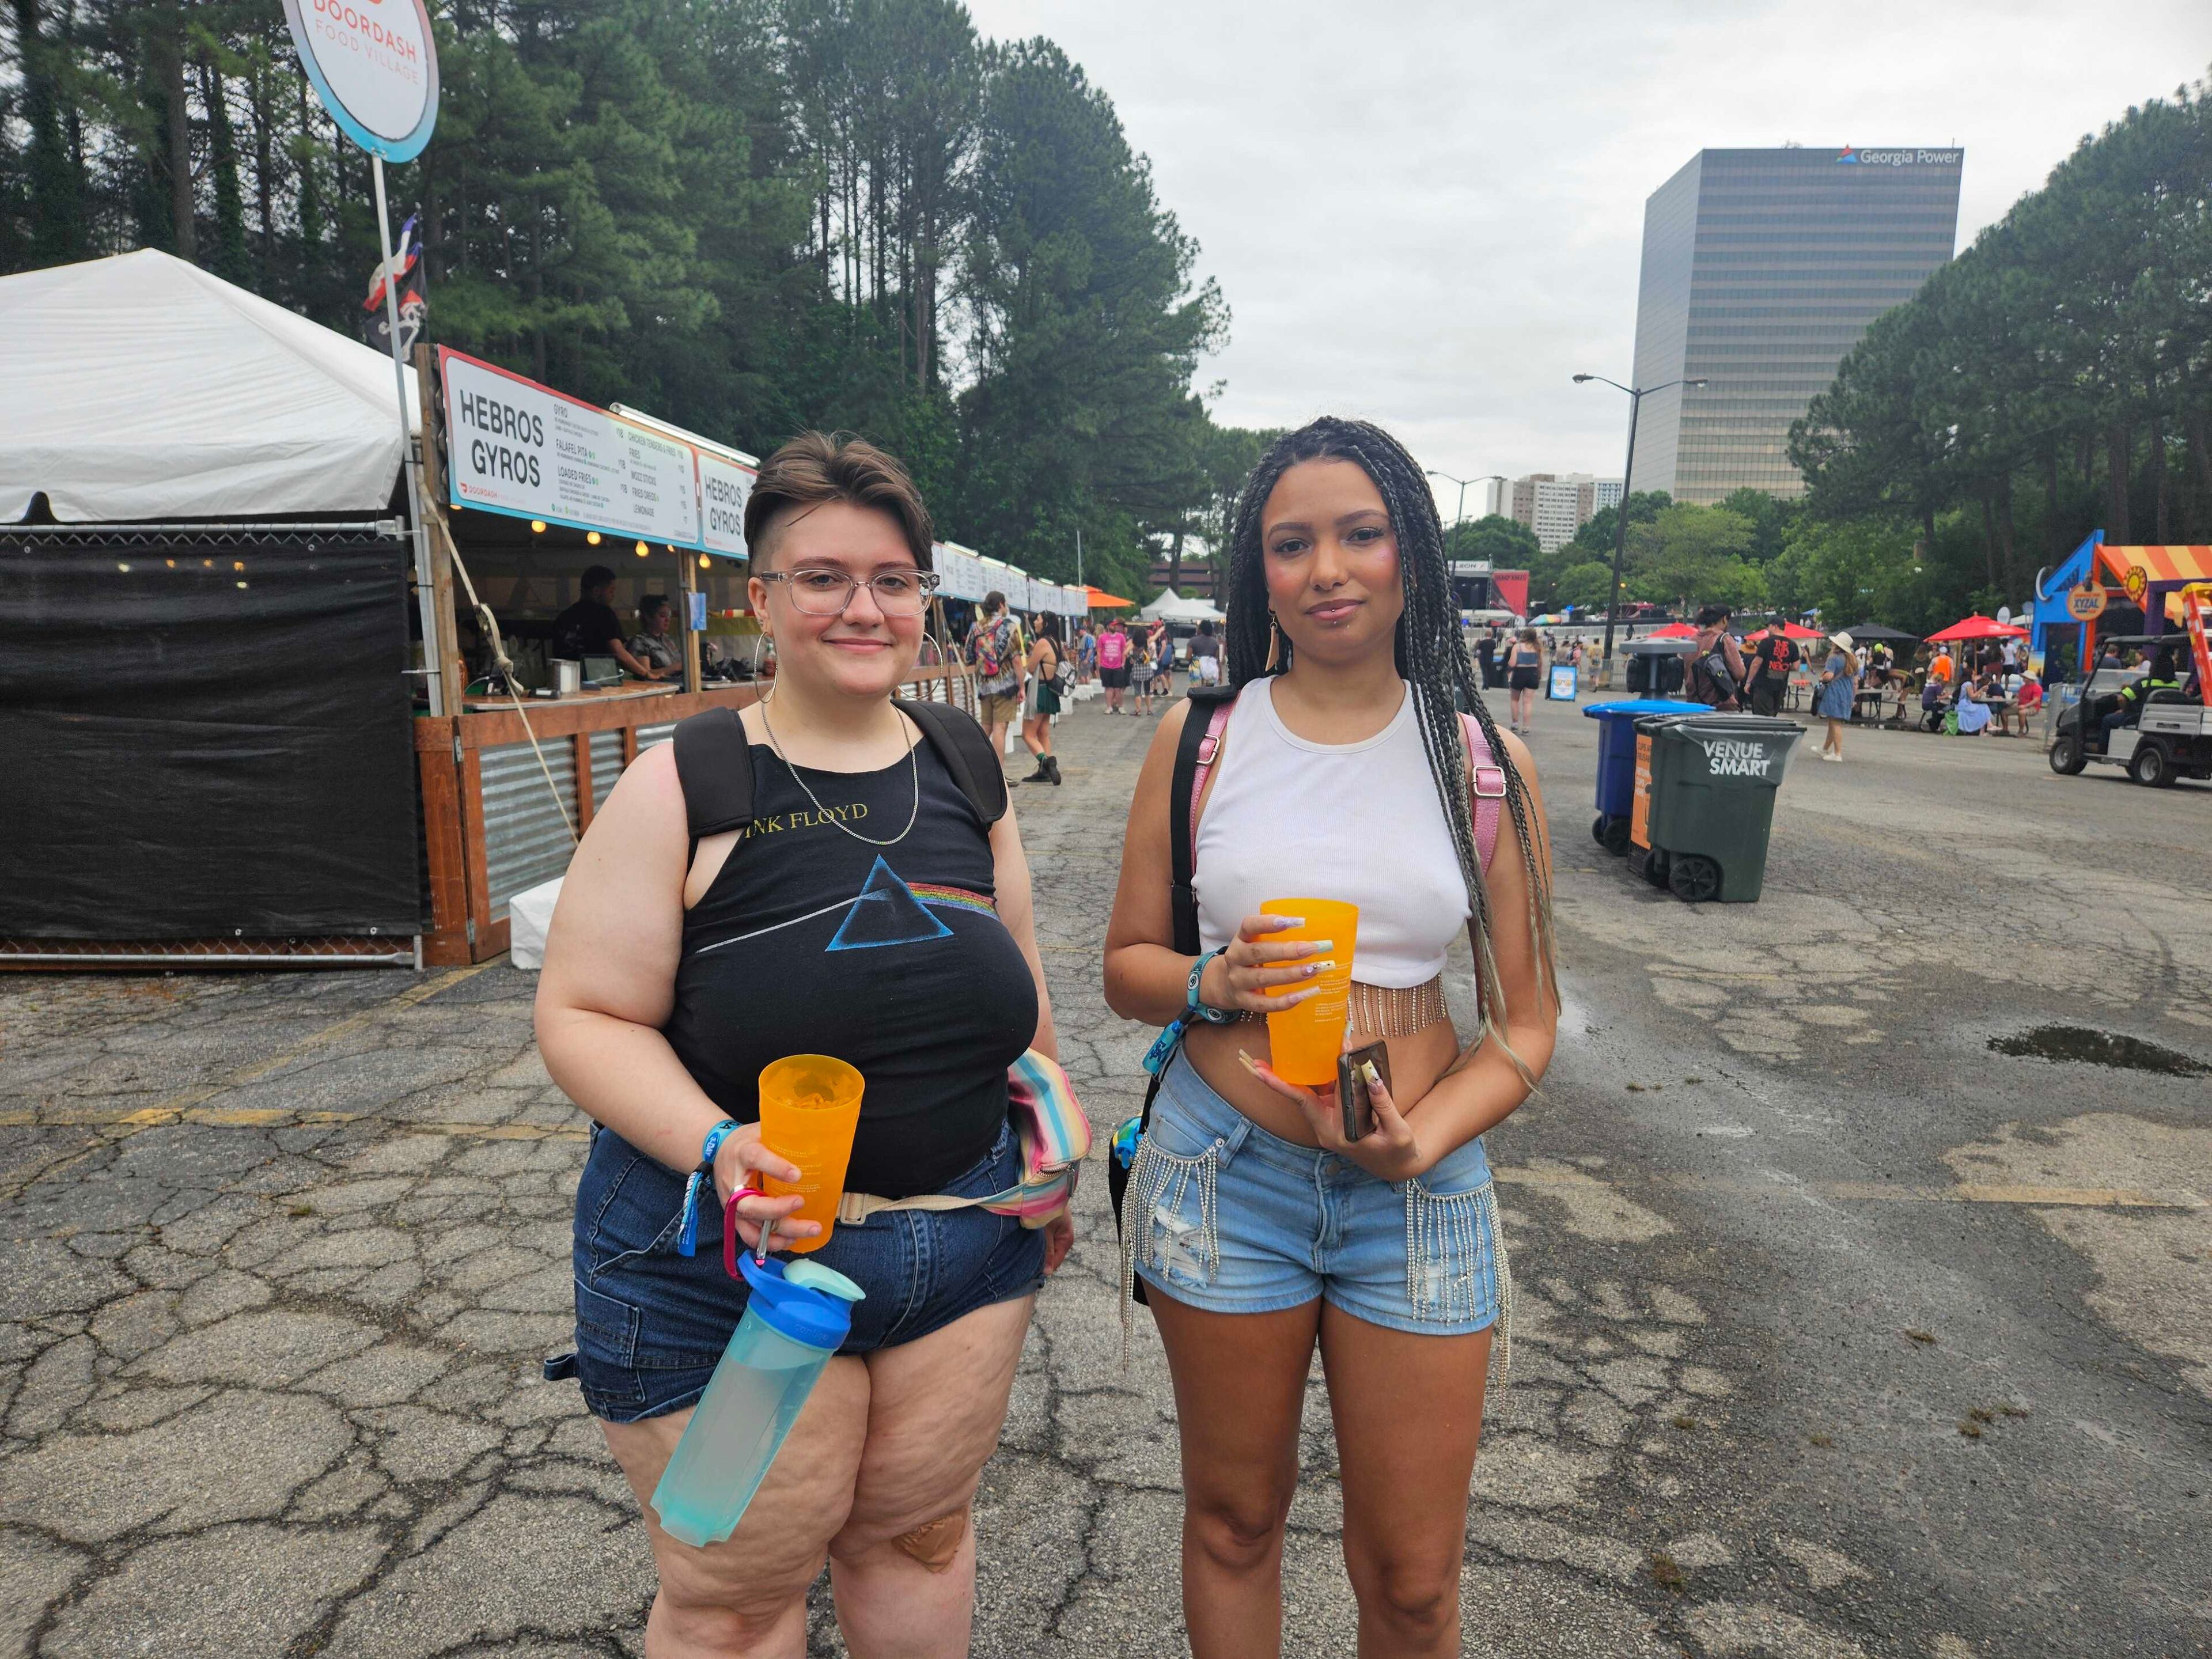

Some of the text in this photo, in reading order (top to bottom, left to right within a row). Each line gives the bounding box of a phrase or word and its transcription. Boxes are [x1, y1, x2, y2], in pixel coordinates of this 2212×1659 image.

[316, 19, 419, 85] FOOD VILLAGE
[1860, 149, 1959, 166] Georgia Power
[460, 389, 544, 448] HEBROS
[556, 438, 577, 455] FALAFEL
[577, 445, 588, 457] PITA
[628, 448, 641, 460] FRIES
[471, 439, 540, 487] GYROS
[558, 465, 577, 480] LOADED
[578, 471, 592, 485] FRIES
[704, 474, 743, 508] HEBROS
[632, 503, 654, 517] LEMONADE
[710, 507, 741, 536] GYROS
[2074, 598, 2099, 609] XYZAL
[1703, 740, 1763, 759] VENUE
[1709, 758, 1770, 777] SMART
[744, 803, 868, 839] INK FLOYD
[705, 1137, 717, 1157] 3-DAY
